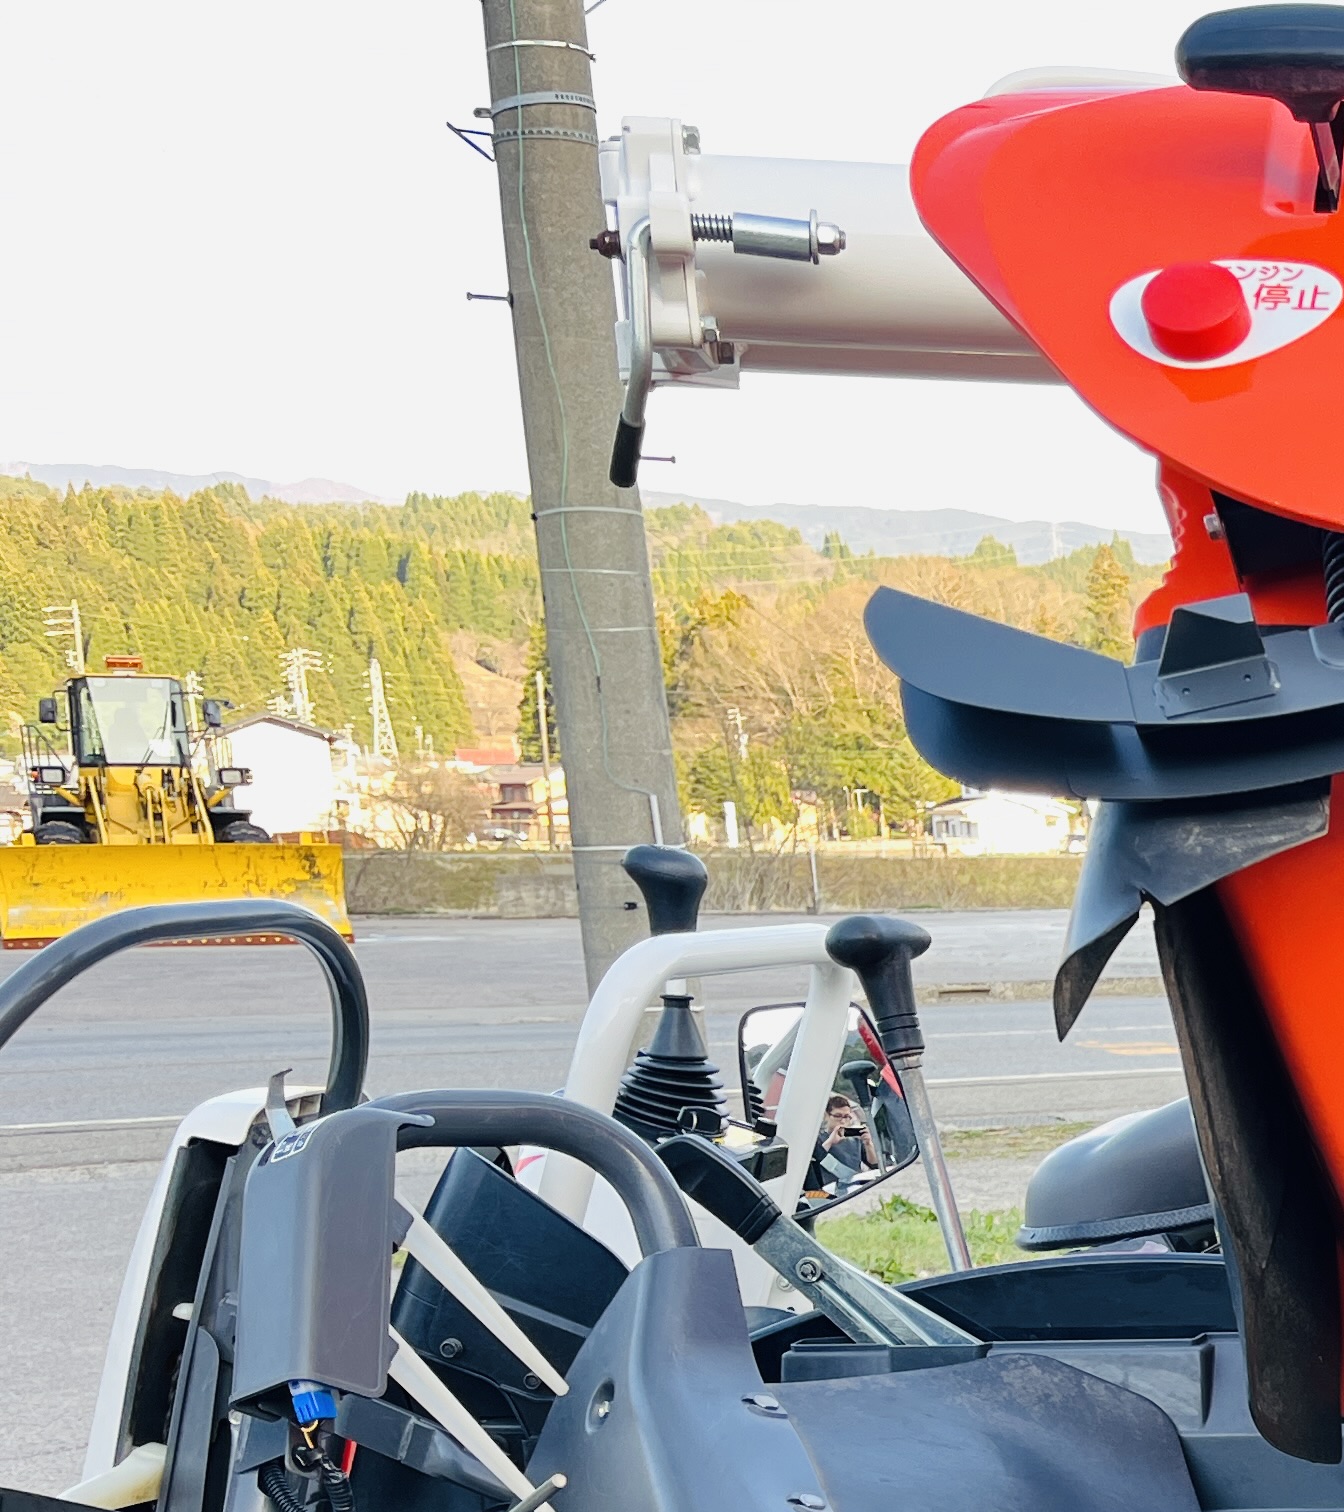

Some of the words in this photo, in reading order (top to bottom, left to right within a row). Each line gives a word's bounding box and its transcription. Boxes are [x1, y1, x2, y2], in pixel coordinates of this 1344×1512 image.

[1227, 265, 1304, 282] ンジン
[1253, 283, 1330, 311] 停止
